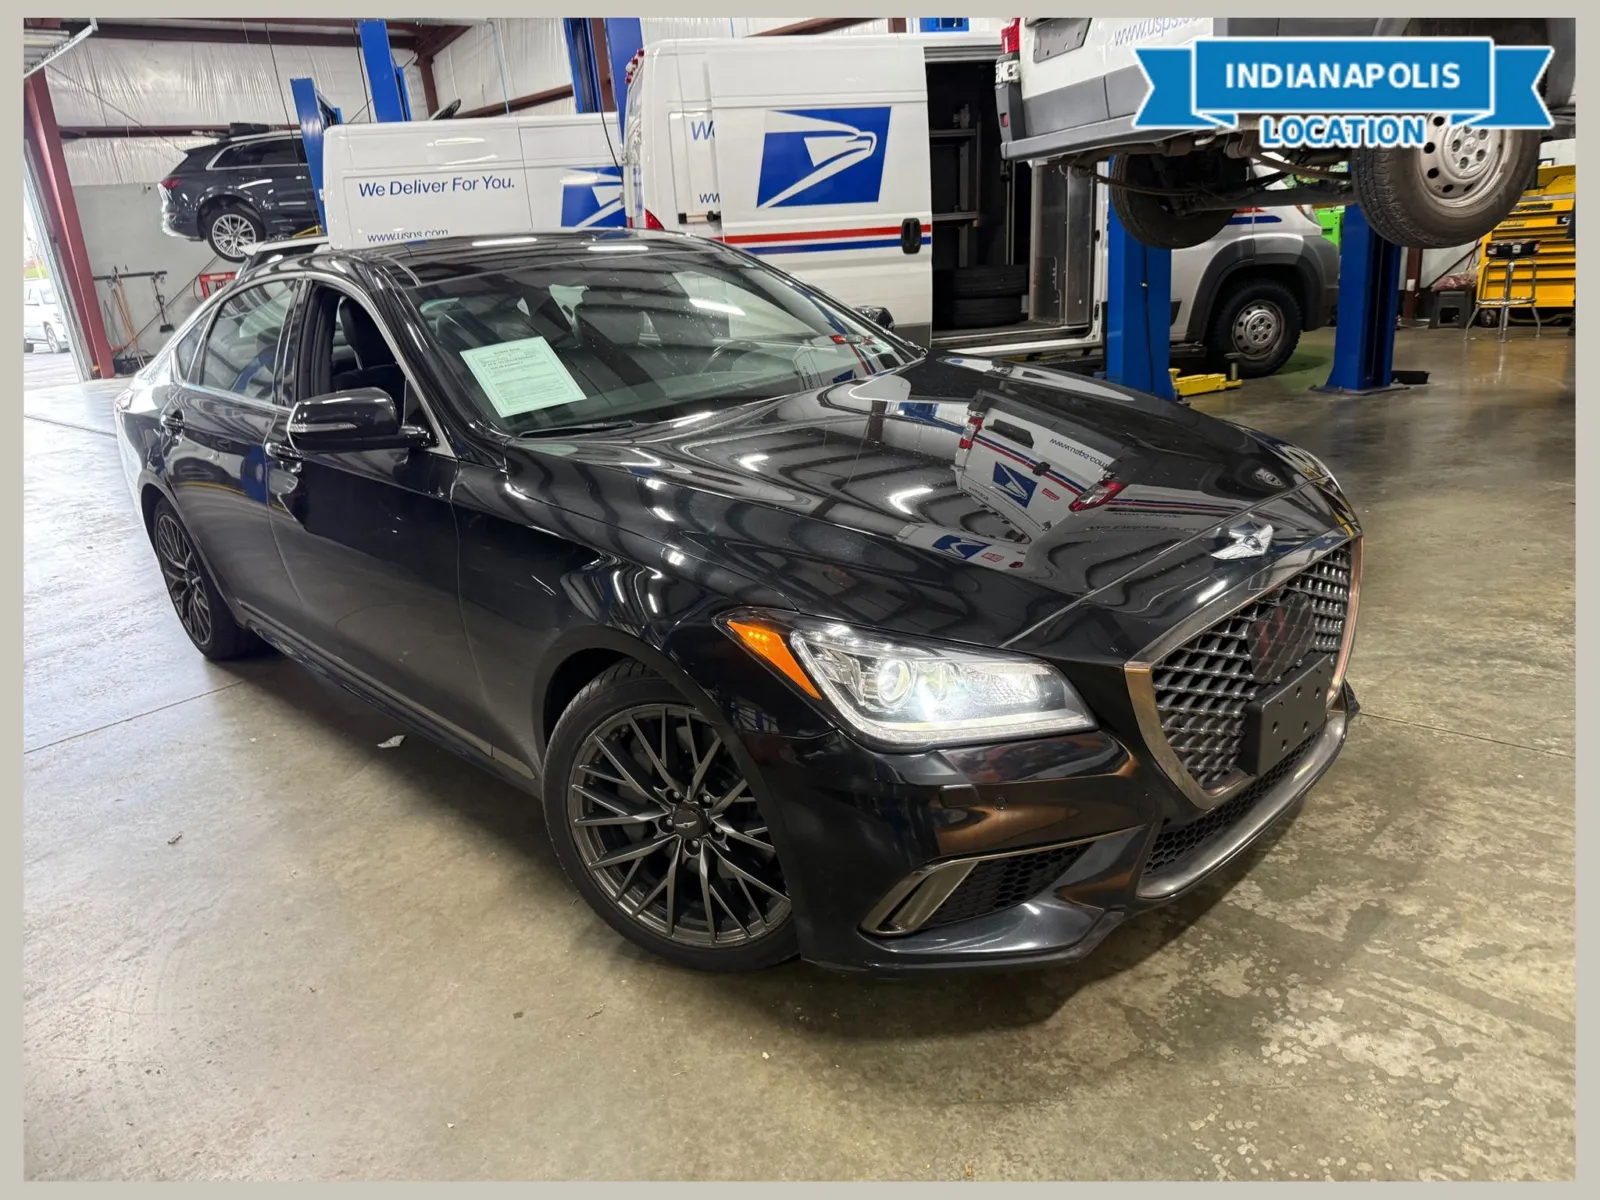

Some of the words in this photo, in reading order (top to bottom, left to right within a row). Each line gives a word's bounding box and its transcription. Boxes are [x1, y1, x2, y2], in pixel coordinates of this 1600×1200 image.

[1114, 17, 1200, 46] www.usps.
[691, 120, 715, 140] W
[358, 182, 386, 197] We
[389, 179, 449, 196] Deliver
[452, 177, 479, 192] For
[482, 175, 515, 190] You.
[367, 229, 449, 243] www.uspscom
